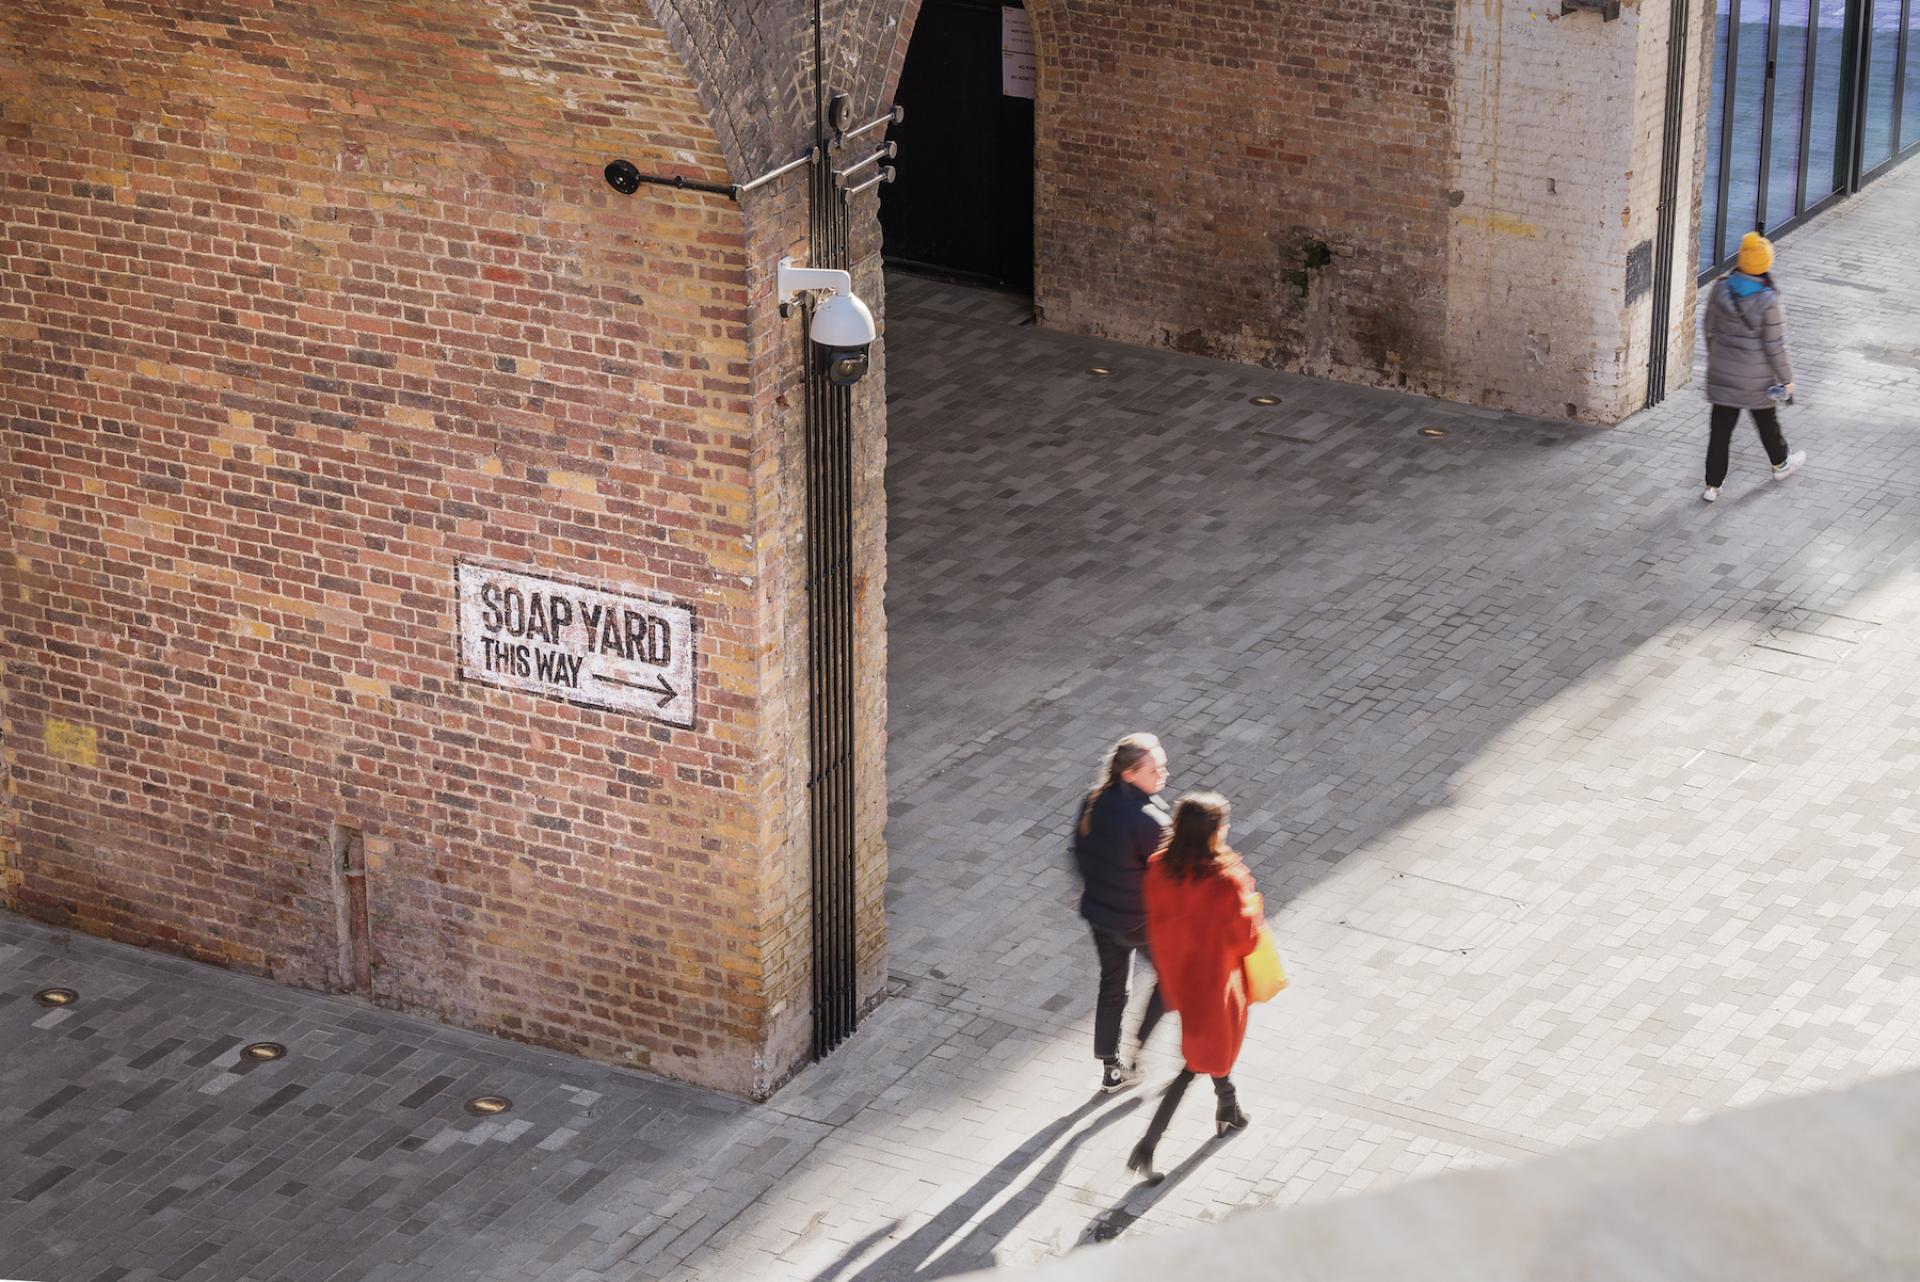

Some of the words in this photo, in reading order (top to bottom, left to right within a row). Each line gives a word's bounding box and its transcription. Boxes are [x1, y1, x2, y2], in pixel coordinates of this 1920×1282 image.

[480, 582, 573, 645] SOAP
[579, 601, 671, 667] YARD
[480, 635, 531, 677] THIS
[535, 647, 583, 689] WAY
